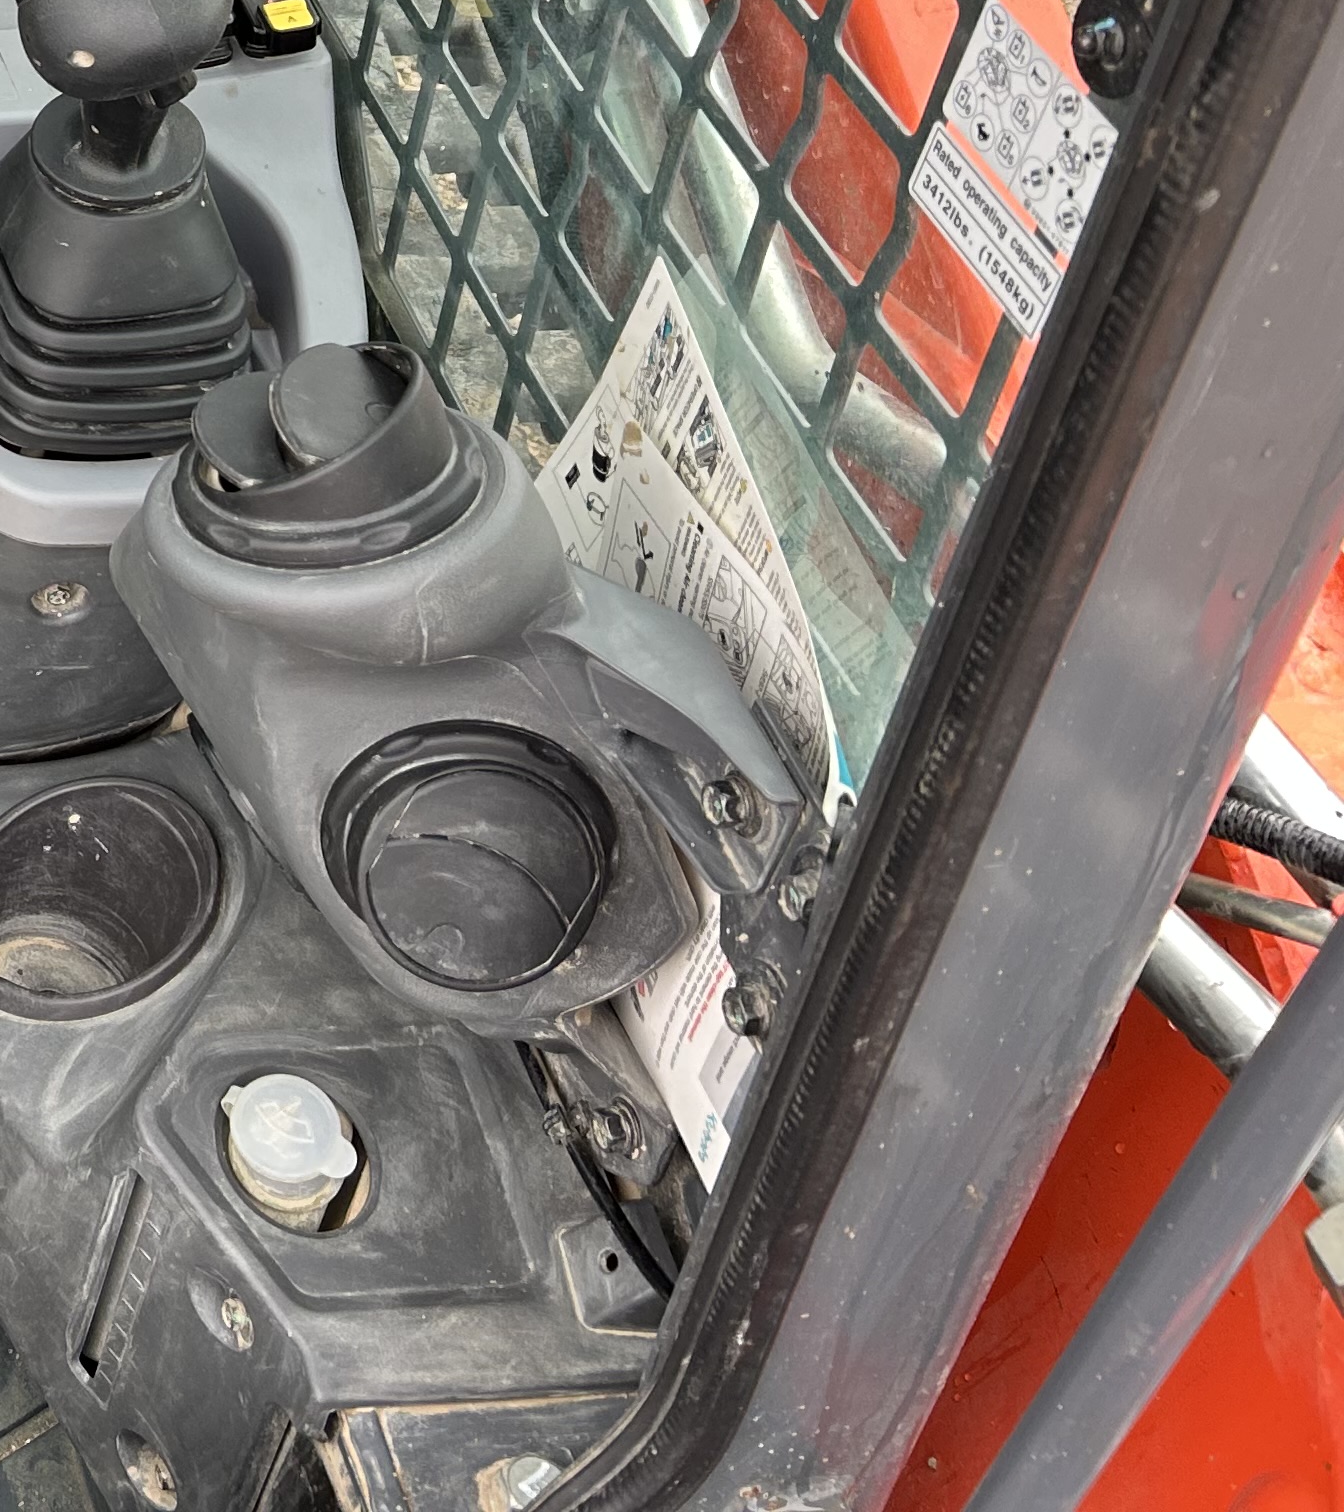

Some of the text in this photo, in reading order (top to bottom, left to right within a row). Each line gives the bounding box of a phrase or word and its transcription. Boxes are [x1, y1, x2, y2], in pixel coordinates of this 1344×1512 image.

[932, 137, 962, 181] Rated
[960, 174, 1009, 242] operating
[1008, 232, 1053, 296] capacity
[976, 241, 1037, 324] (1548kg)
